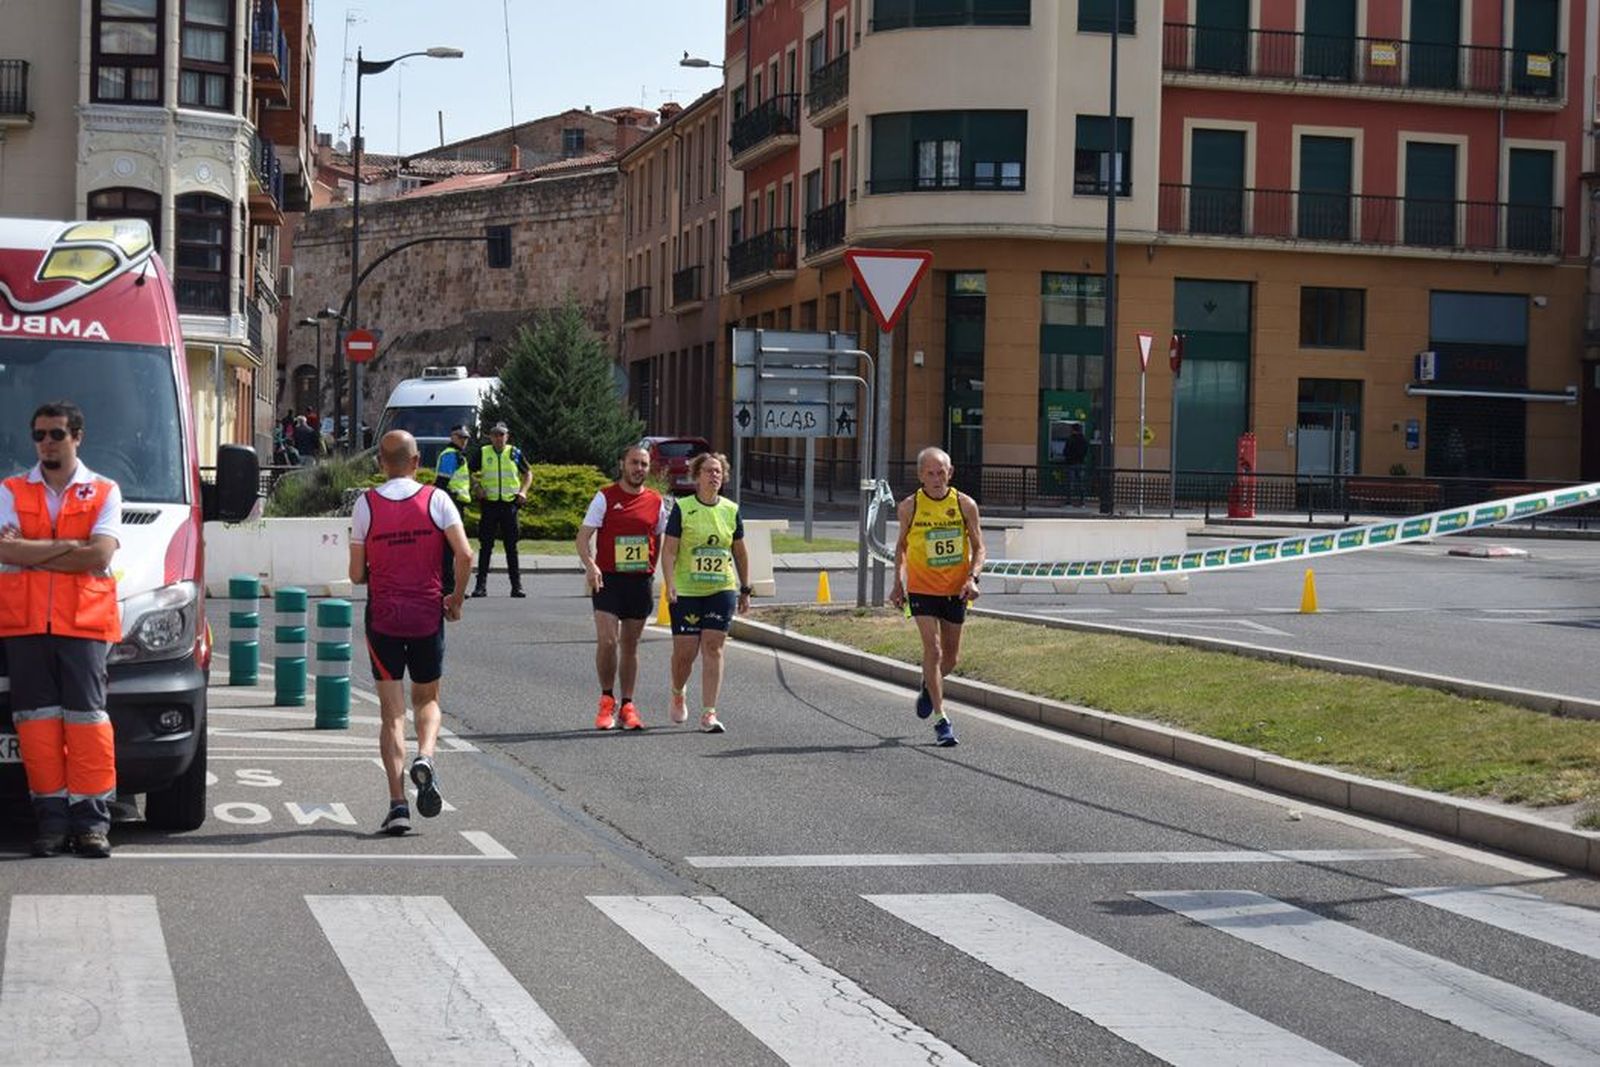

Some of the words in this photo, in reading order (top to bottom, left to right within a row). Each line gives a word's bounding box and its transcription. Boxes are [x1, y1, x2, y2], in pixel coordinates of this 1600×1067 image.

[625, 546, 641, 560] 21
[935, 539, 956, 556] 65
[695, 557, 723, 572] 132
